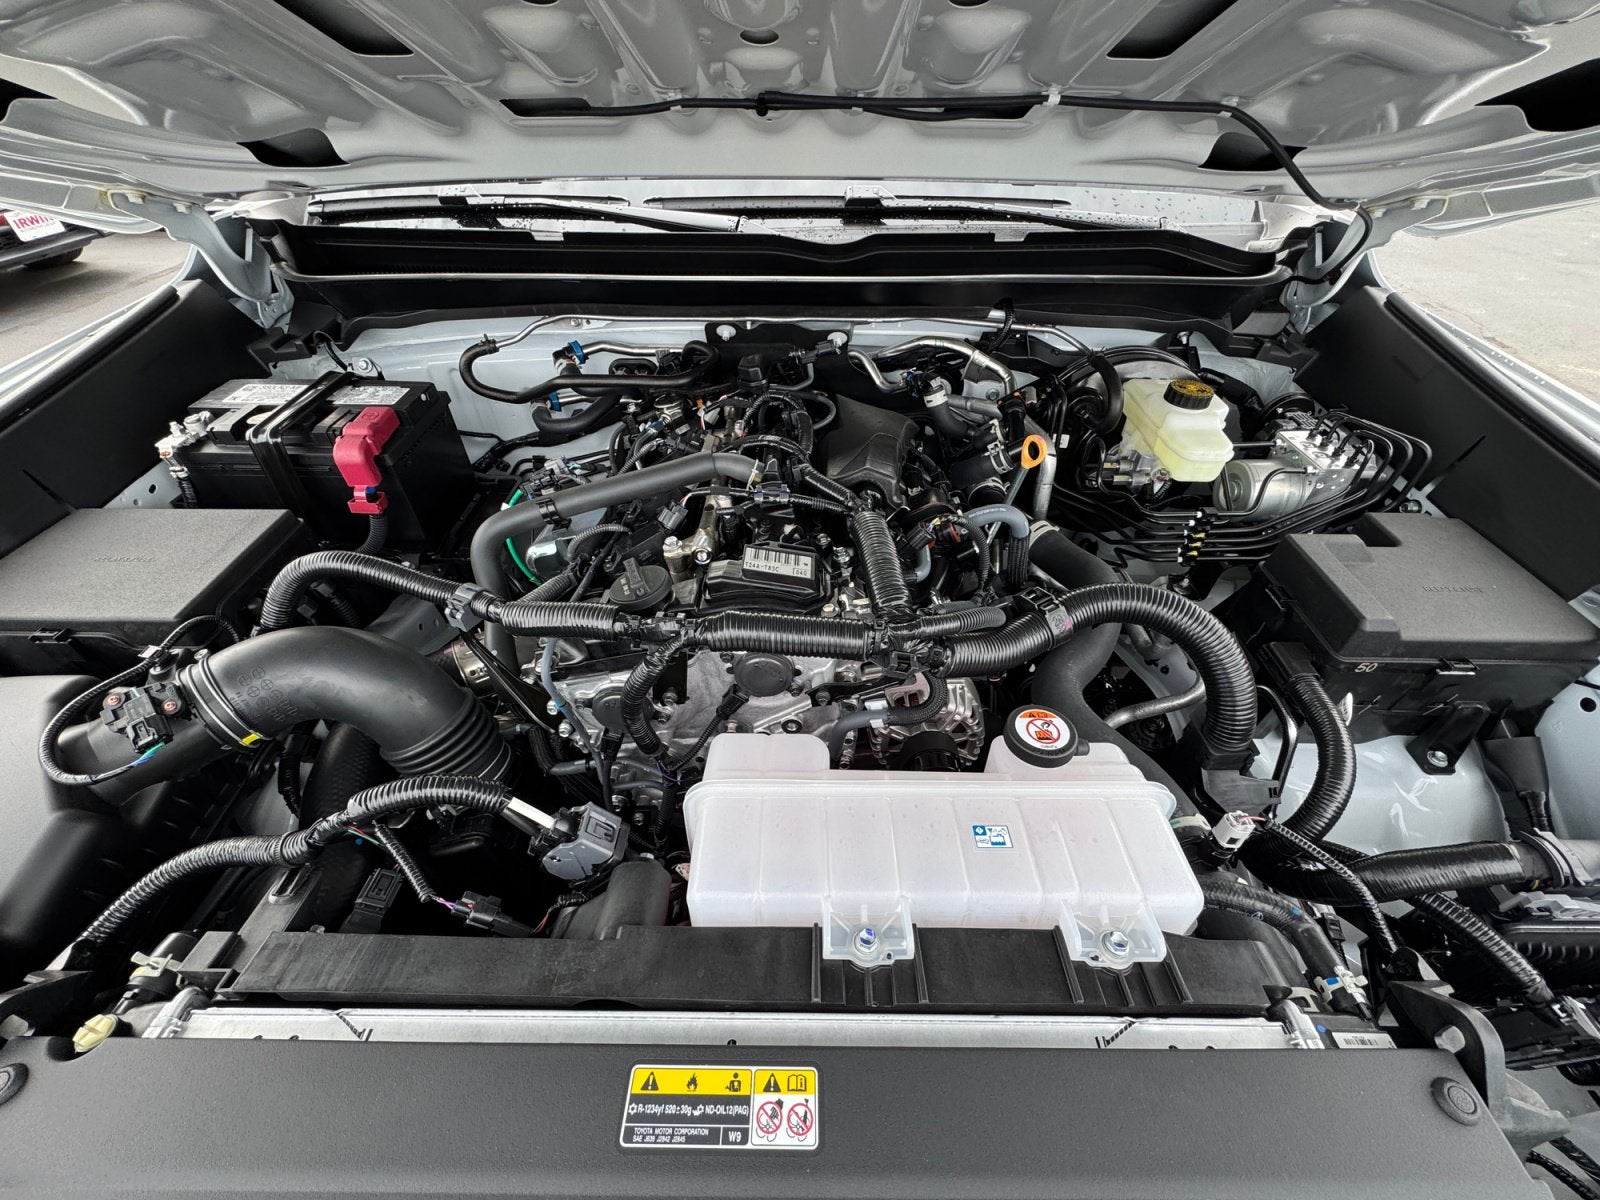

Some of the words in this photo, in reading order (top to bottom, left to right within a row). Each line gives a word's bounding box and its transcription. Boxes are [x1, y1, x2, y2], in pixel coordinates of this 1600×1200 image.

[1354, 662, 1379, 673] 50
[637, 1103, 664, 1116] R-1234yf
[654, 1127, 672, 1135] MOTOR
[674, 1128, 709, 1136] CORPORATION
[728, 1131, 742, 1143] W9
